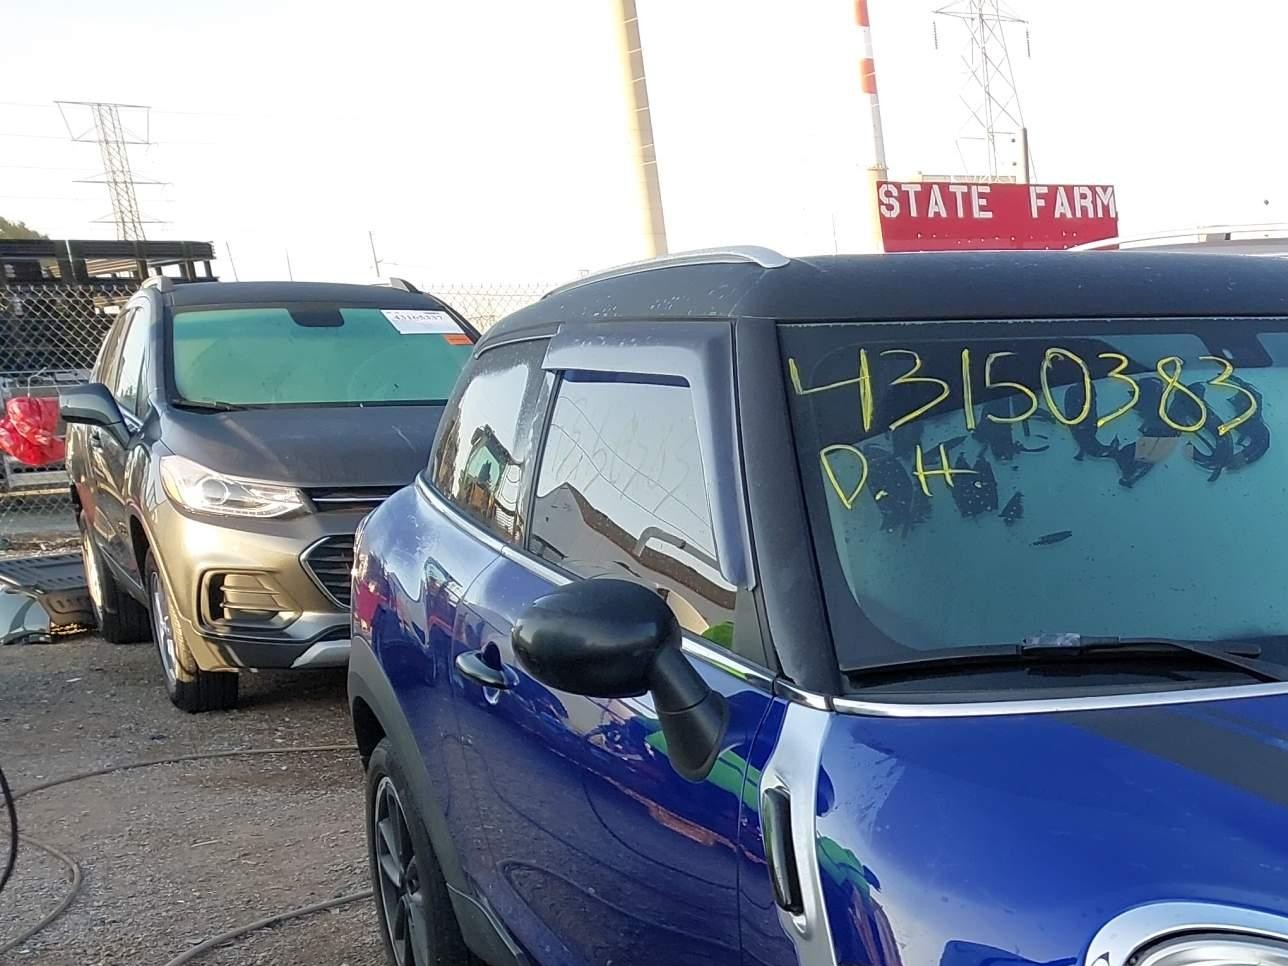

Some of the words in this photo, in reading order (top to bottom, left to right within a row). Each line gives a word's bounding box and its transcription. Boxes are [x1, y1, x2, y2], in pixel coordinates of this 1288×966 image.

[879, 184, 993, 218] STATE
[1028, 185, 1117, 218] FARM
[788, 347, 1258, 437] 43150383
